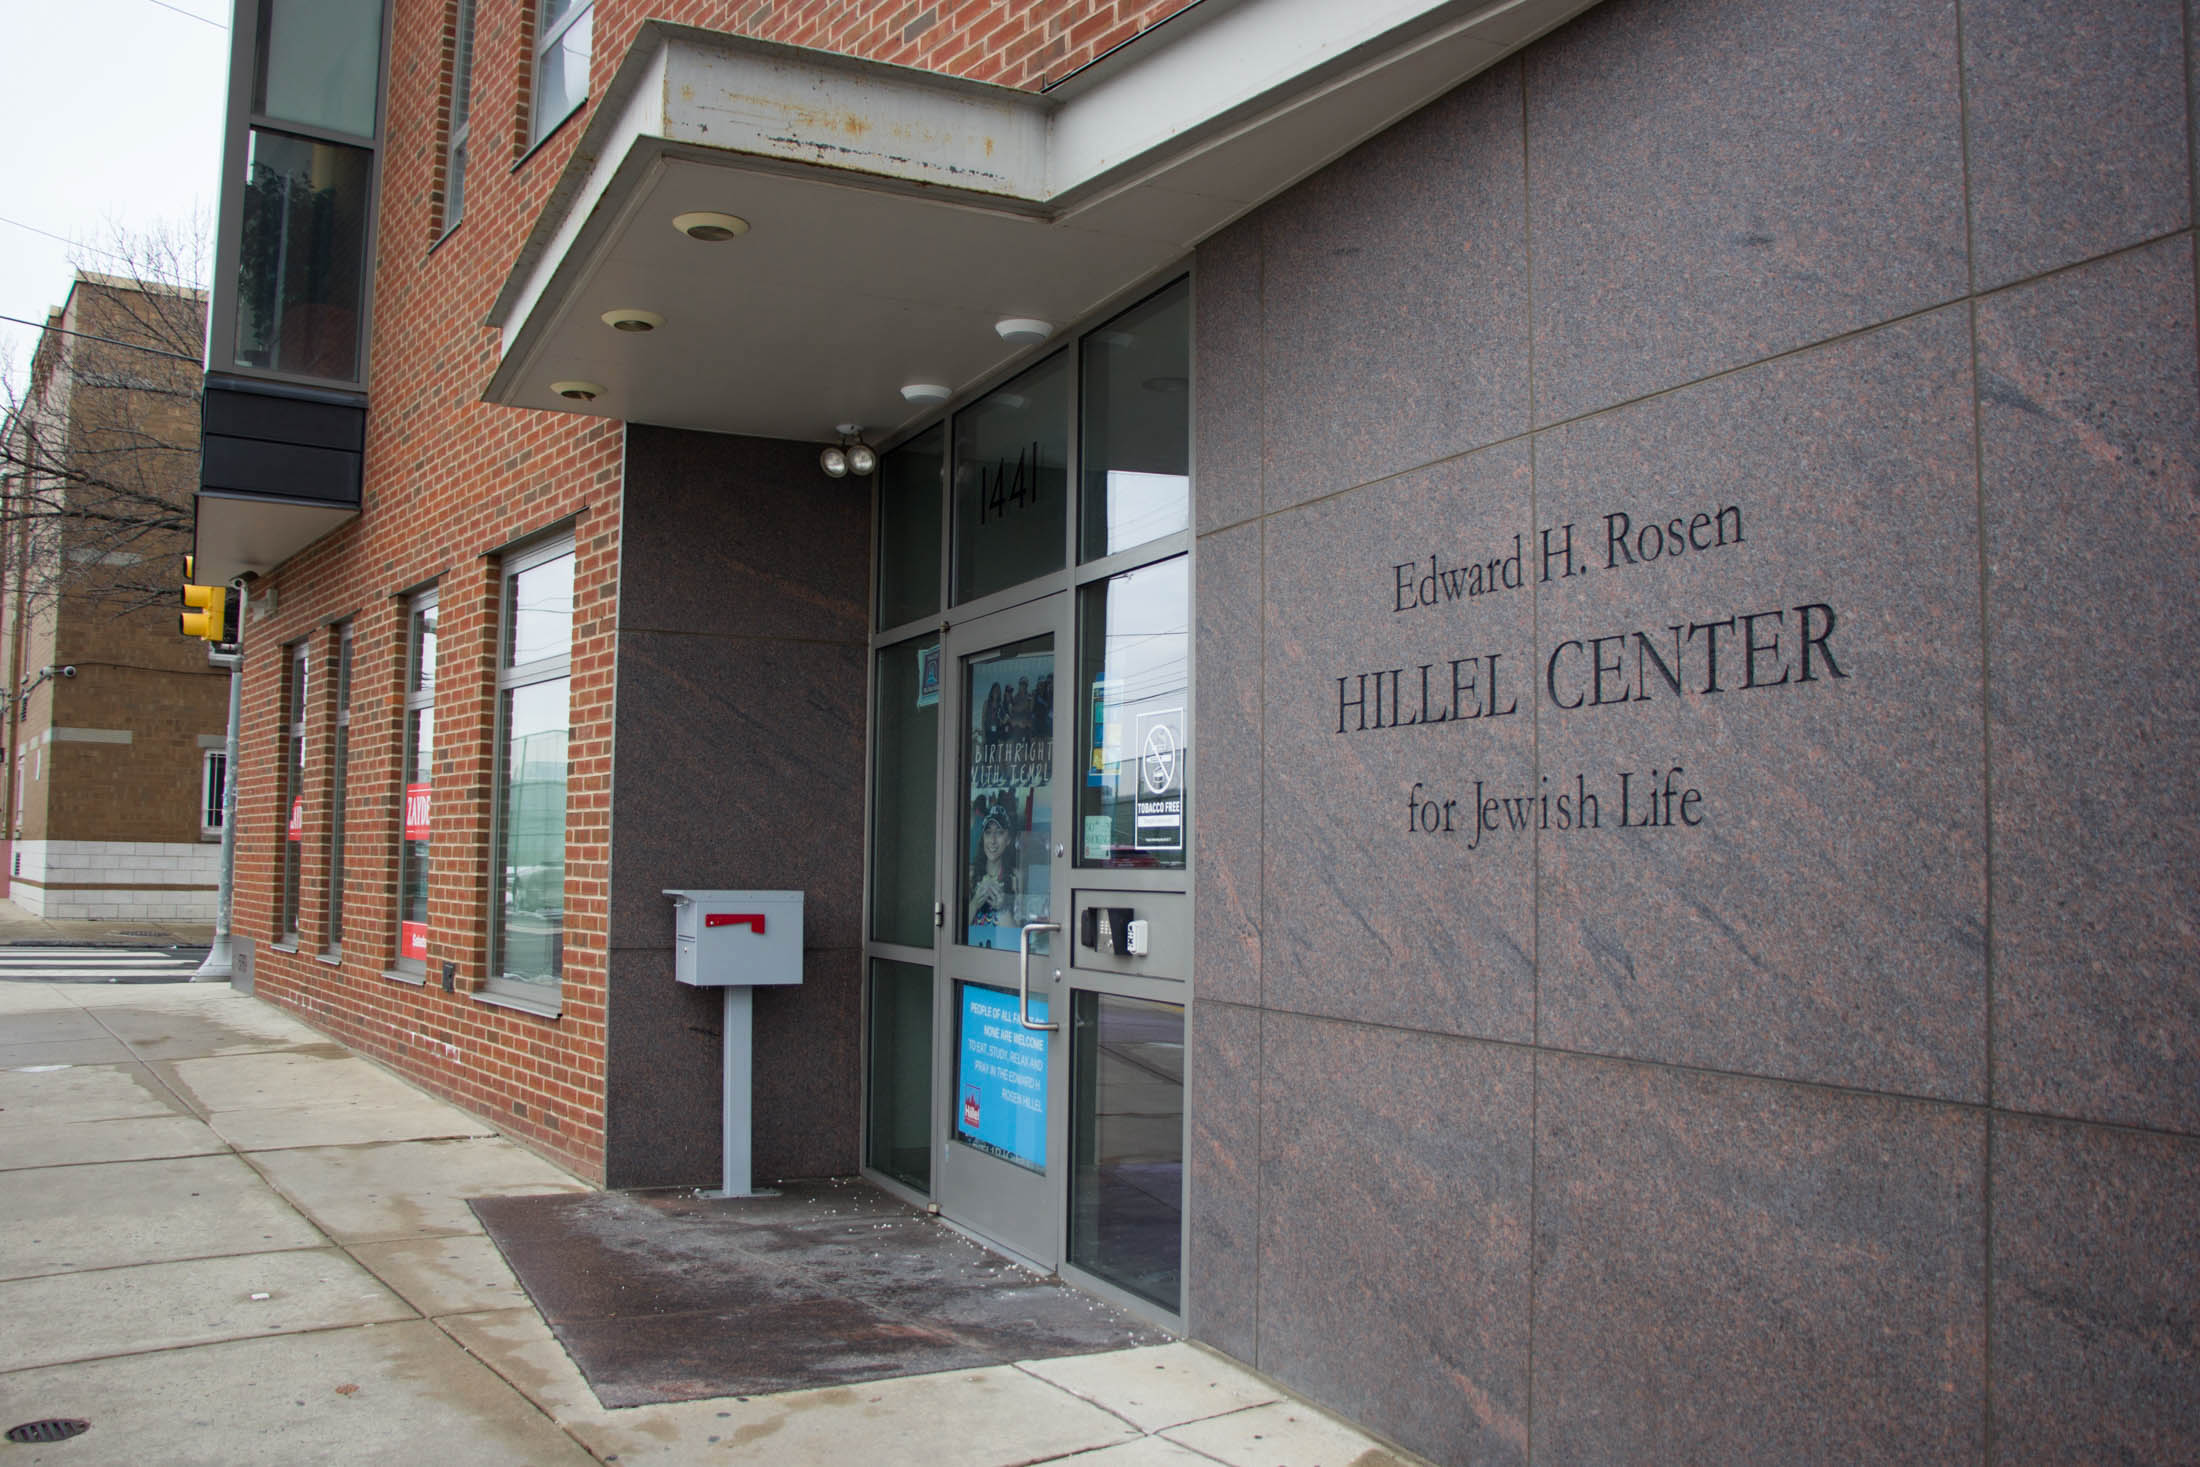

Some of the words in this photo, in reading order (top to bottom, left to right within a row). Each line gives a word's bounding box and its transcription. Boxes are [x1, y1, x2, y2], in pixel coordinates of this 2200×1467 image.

[980, 440, 1038, 525] 1441
[1391, 534, 1524, 613] Edward
[1539, 523, 1587, 583] H.
[1602, 503, 1745, 570] Rosen
[1336, 653, 1518, 734] HILLEL
[1546, 602, 1850, 710] CENTER
[975, 741, 1053, 763] BIRTHRIGHT
[1138, 802, 1164, 814] TOBACCO
[1165, 801, 1180, 813] FREE
[1408, 782, 1456, 833] for
[1468, 773, 1601, 850] Jewish
[1618, 767, 1703, 828] Life
[970, 1002, 992, 1017] PEOPLE
[992, 1007, 1001, 1019] OF
[1001, 1009, 1012, 1024] ALL
[968, 1038, 976, 1050] TO
[984, 1024, 1000, 1039] NONE
[1000, 1028, 1012, 1043] ARE
[1013, 1032, 1044, 1052] WELCOME
[996, 1067, 1008, 1080] THE
